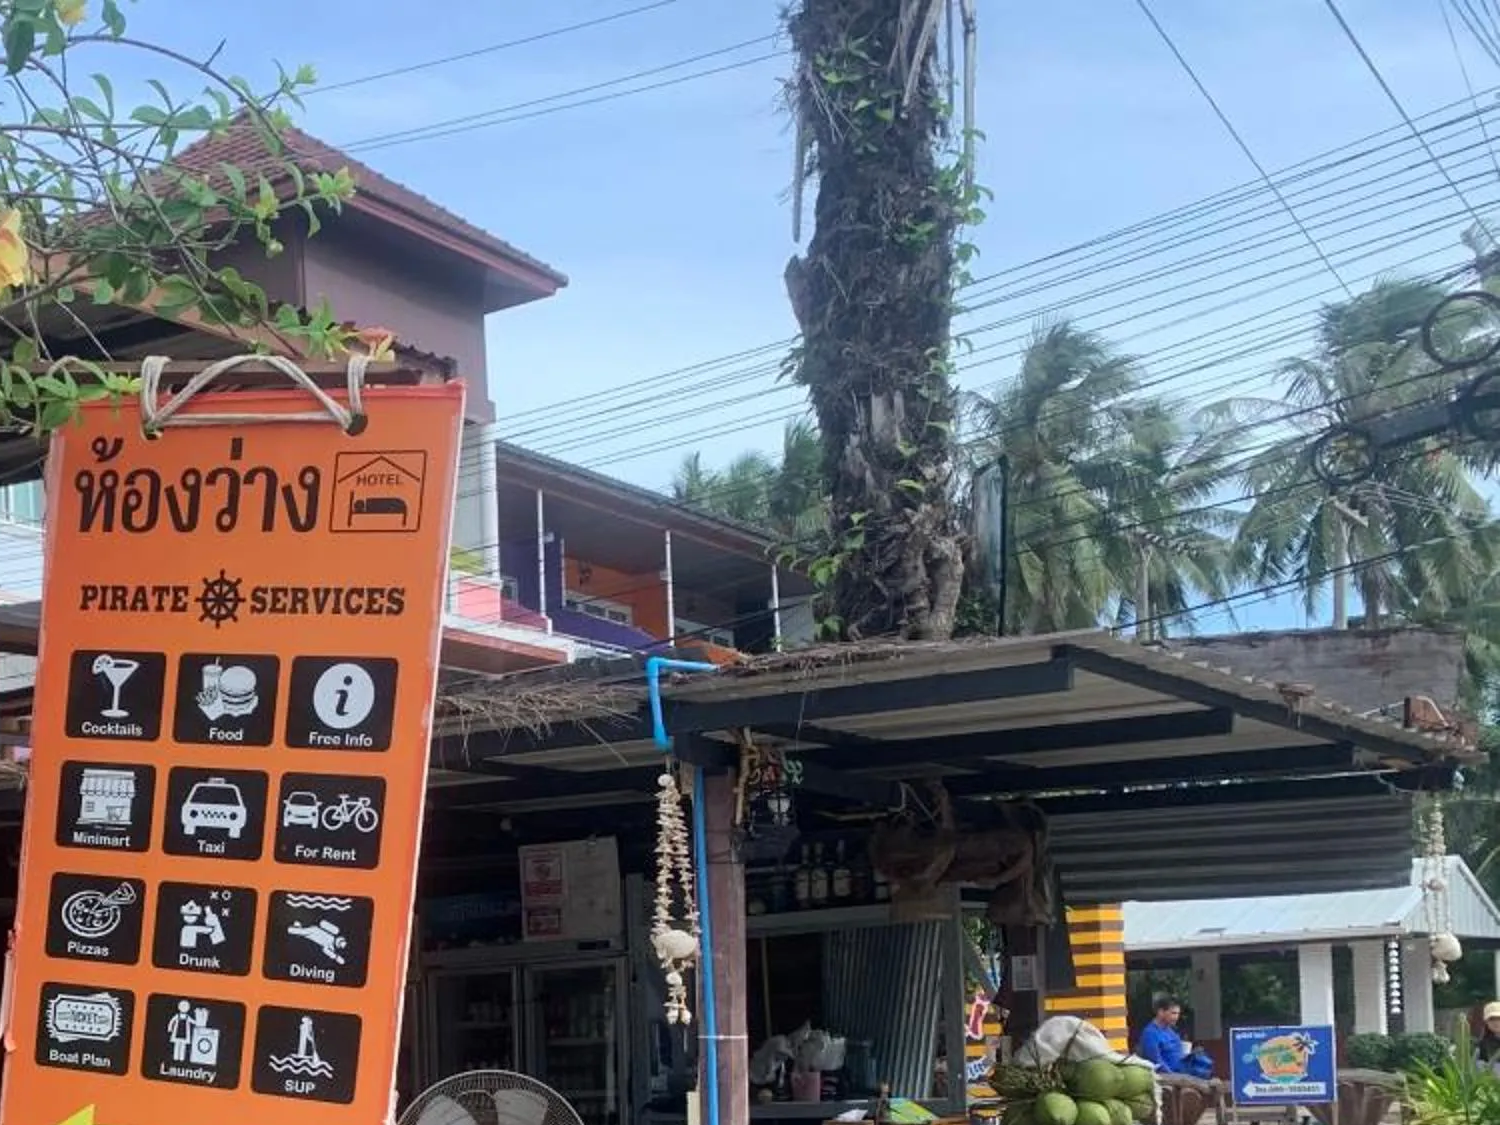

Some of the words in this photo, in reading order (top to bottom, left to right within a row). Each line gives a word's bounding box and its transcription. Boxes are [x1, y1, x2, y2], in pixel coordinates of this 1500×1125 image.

[73, 436, 320, 533] ห้องว่าง
[355, 473, 403, 487] HOTEL
[79, 584, 188, 613] PIRATE
[250, 586, 405, 616] SERVICES
[81, 721, 142, 737] Cocktails
[209, 728, 243, 742] Food
[308, 731, 341, 745] Free
[344, 732, 373, 747] Info
[73, 831, 131, 847] Minimart
[197, 840, 225, 854] Taxi
[295, 845, 318, 859] For
[322, 847, 357, 861] Rent
[67, 941, 109, 956] Pizzas
[179, 953, 221, 969] Drunk
[290, 964, 336, 983] Diving
[50, 1049, 79, 1064] Boat
[82, 1053, 111, 1067] Plan
[159, 1063, 217, 1083] Laundry
[284, 1080, 316, 1094] SUP
